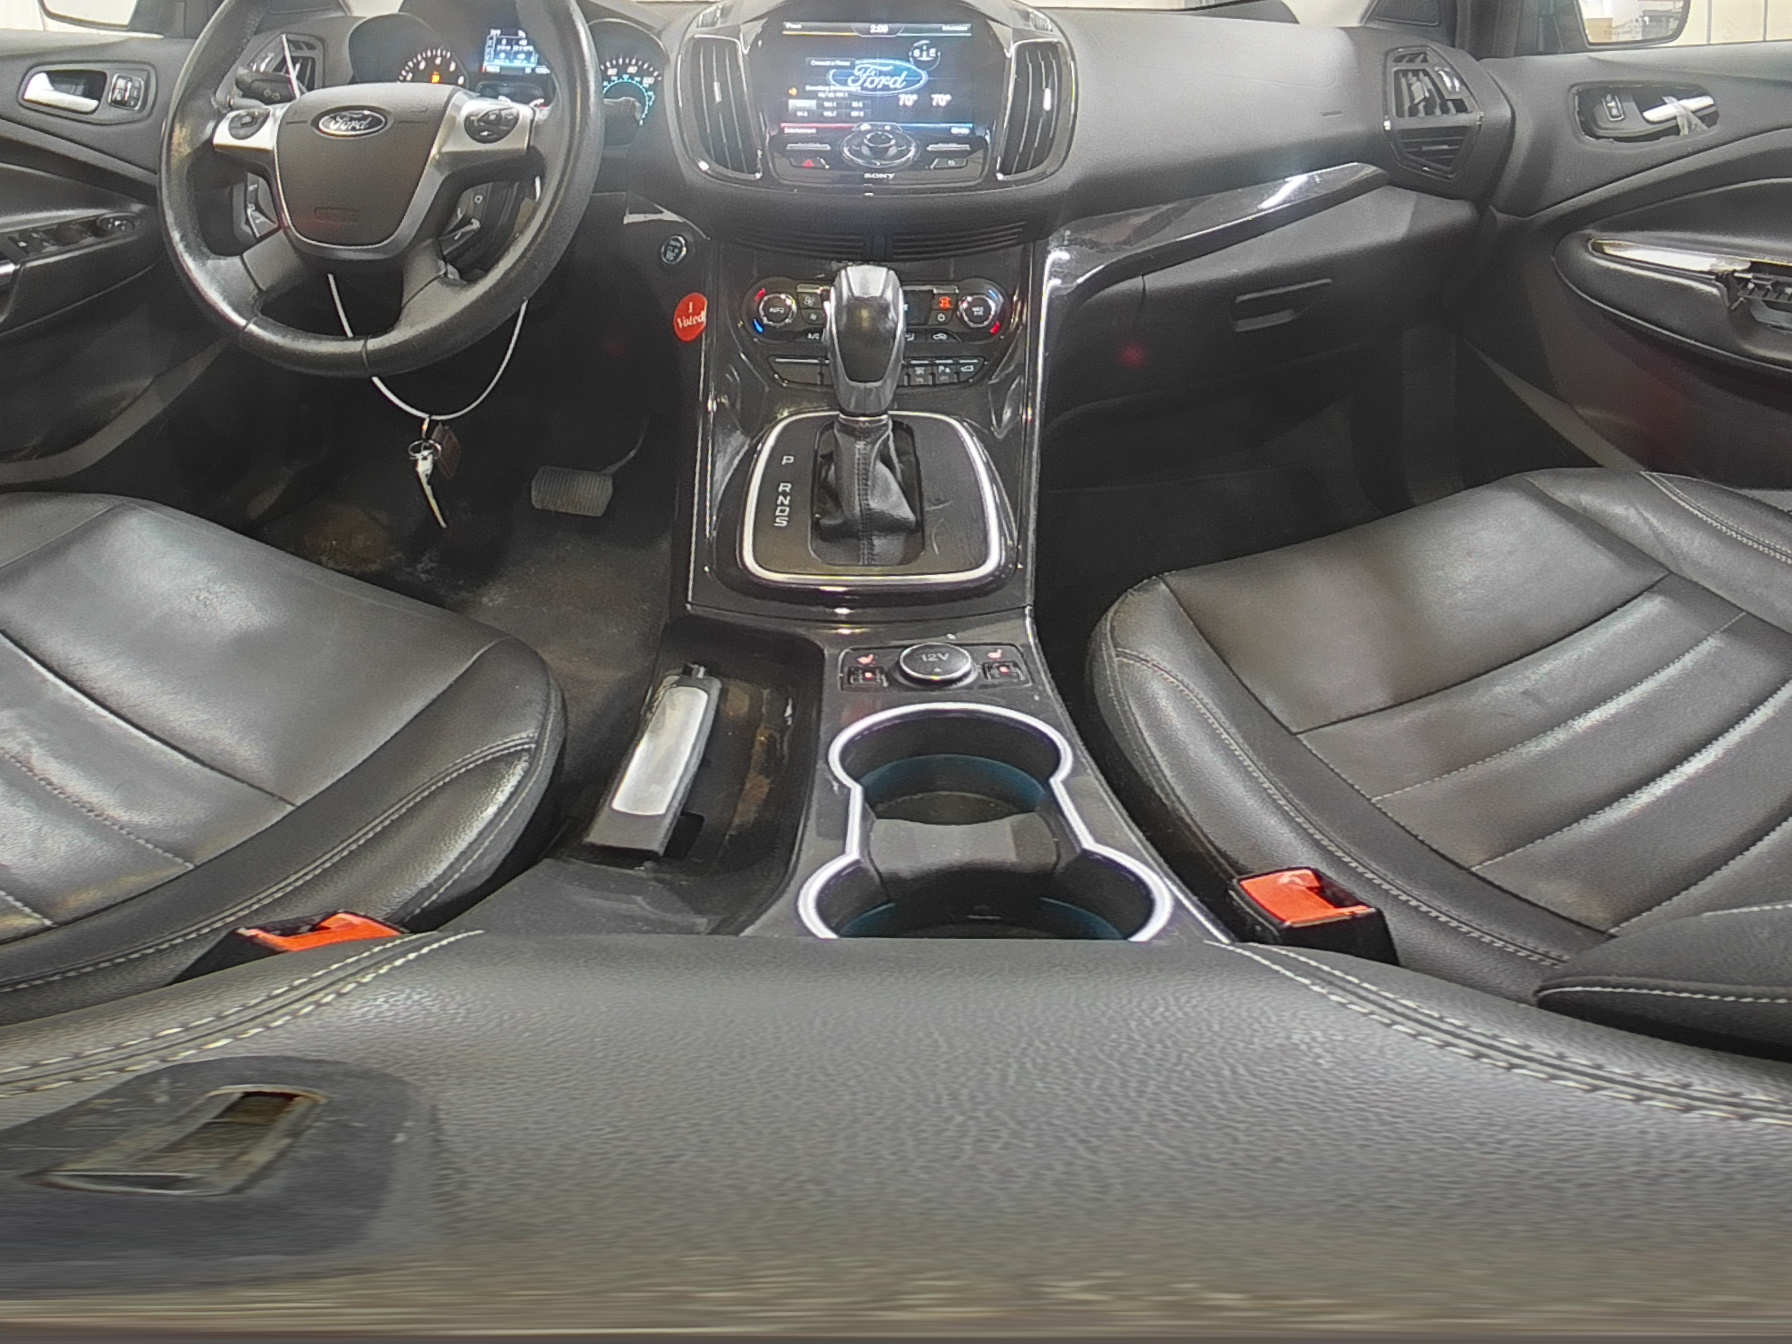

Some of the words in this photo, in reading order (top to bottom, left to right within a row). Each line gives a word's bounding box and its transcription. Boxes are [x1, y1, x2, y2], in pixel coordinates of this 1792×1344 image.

[848, 64, 907, 90] Ford
[326, 112, 373, 131] Ford
[676, 310, 706, 329] Voted
[781, 455, 794, 466] P
[778, 483, 792, 492] R
[777, 496, 791, 505] N
[776, 506, 790, 515] D
[773, 516, 788, 527] S
[919, 652, 950, 662] 12V
